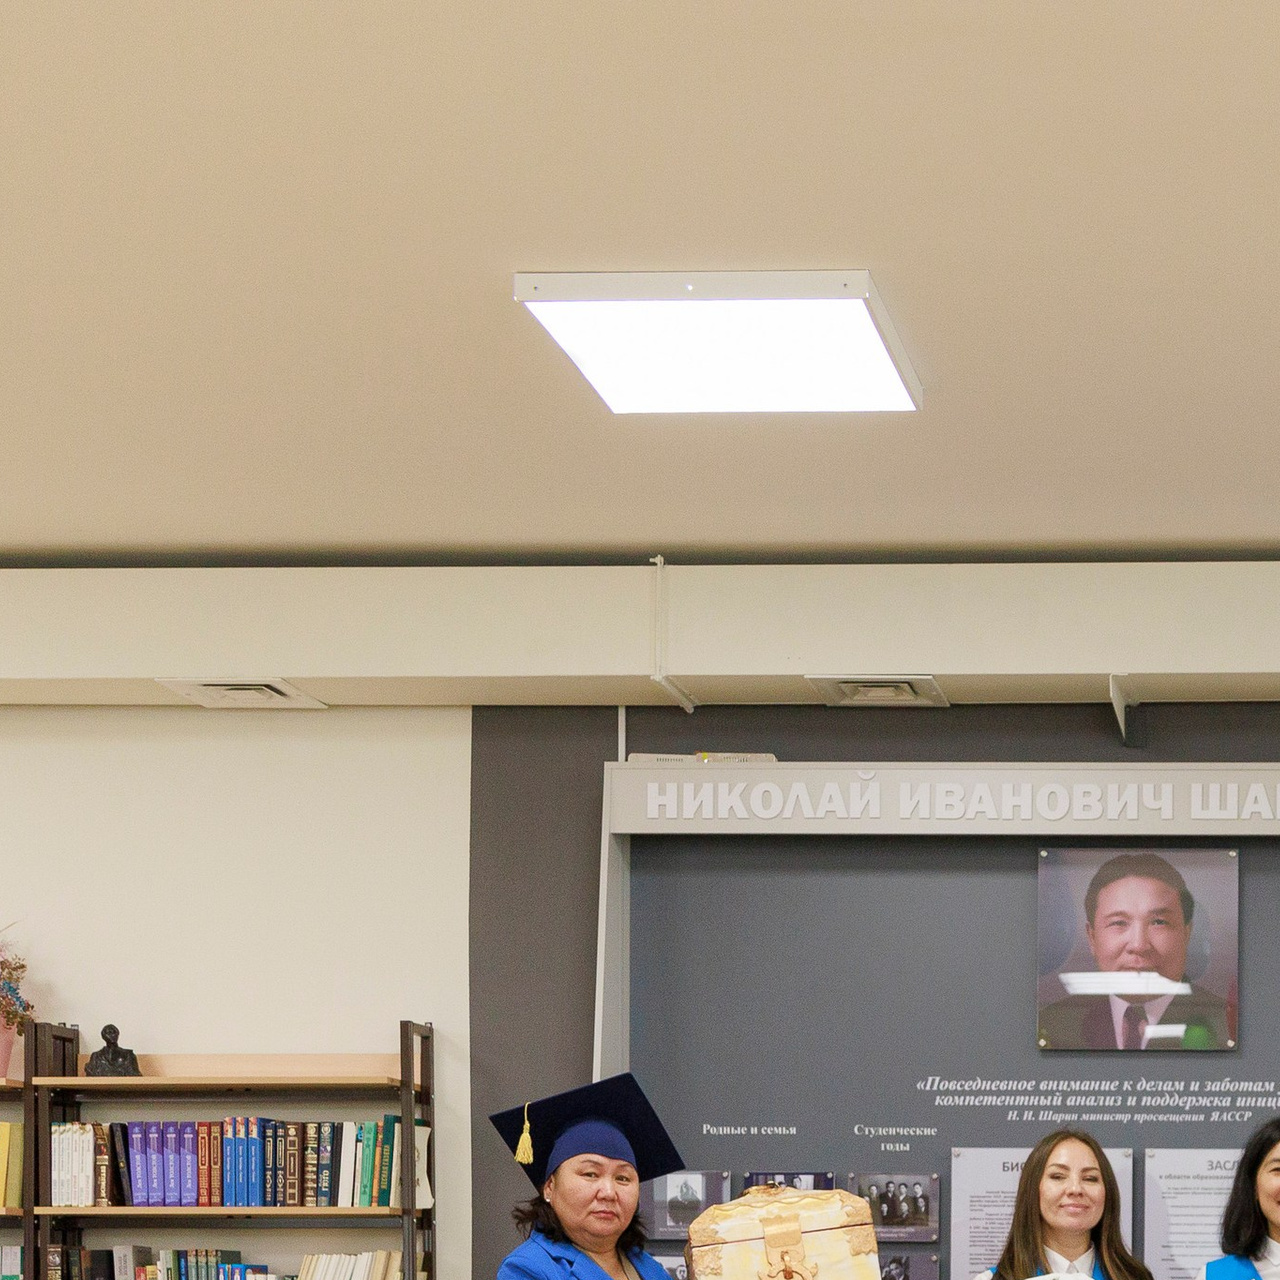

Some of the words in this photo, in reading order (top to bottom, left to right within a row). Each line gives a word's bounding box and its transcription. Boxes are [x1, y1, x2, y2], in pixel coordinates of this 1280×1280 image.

[647, 771, 881, 820] НИКОЛАЙ
[899, 782, 1174, 820] ИВАНОВИЧ
[916, 1075, 1036, 1091] «Повседневное
[1039, 1079, 1118, 1091] внимание
[1122, 1079, 1133, 1091] к
[1136, 1077, 1185, 1092] делам
[1189, 1080, 1200, 1092] и
[1204, 1077, 1275, 1093] заботам
[934, 1092, 1063, 1106] компетентный
[1066, 1094, 1122, 1106] анализ
[1126, 1095, 1137, 1106] и
[1141, 1093, 1231, 1110] поддержка
[1007, 1110, 1019, 1121] Н.
[1023, 1110, 1036, 1121] И.
[1039, 1110, 1078, 1123] Шарин
[1080, 1112, 1131, 1123] министр
[1133, 1112, 1205, 1124] просвещения
[1210, 1110, 1253, 1122] ЯАССР
[702, 1123, 748, 1136] Родные
[750, 1126, 758, 1135] и
[761, 1126, 797, 1135] семья
[853, 1123, 938, 1138] Студенческие
[880, 1142, 911, 1152] годы
